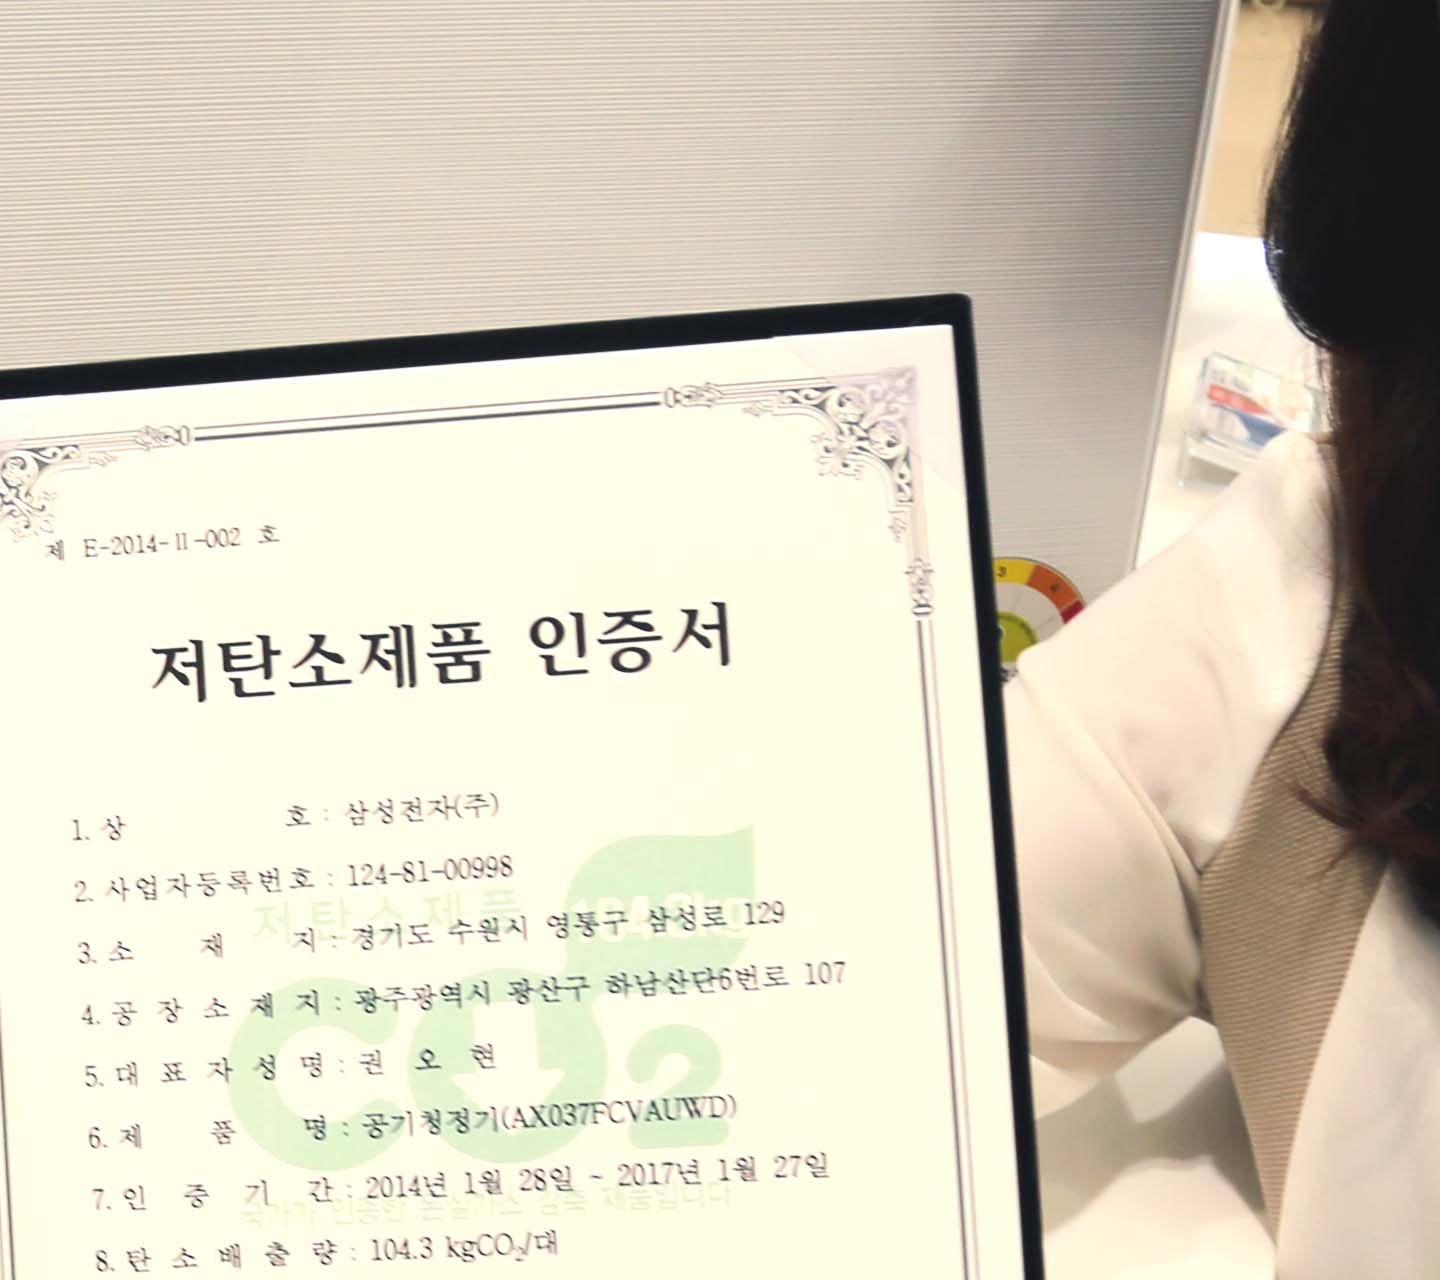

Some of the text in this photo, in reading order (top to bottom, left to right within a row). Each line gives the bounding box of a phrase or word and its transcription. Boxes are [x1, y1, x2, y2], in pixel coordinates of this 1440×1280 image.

[151, 601, 730, 703] 저탄소제품 인증서
[345, 793, 499, 826] 삼성전자(주)
[107, 855, 513, 902] 사업자등록번호 124-81-00998
[353, 901, 785, 951] 경기도 수원시 영통구 삼성로 129
[354, 961, 846, 1014] 광주광역시 광산구 하남산단6번로 107
[366, 1152, 829, 1199] 2014년 1월 28일 2017년 1월 27일
[372, 1236, 433, 1261] 104.3
